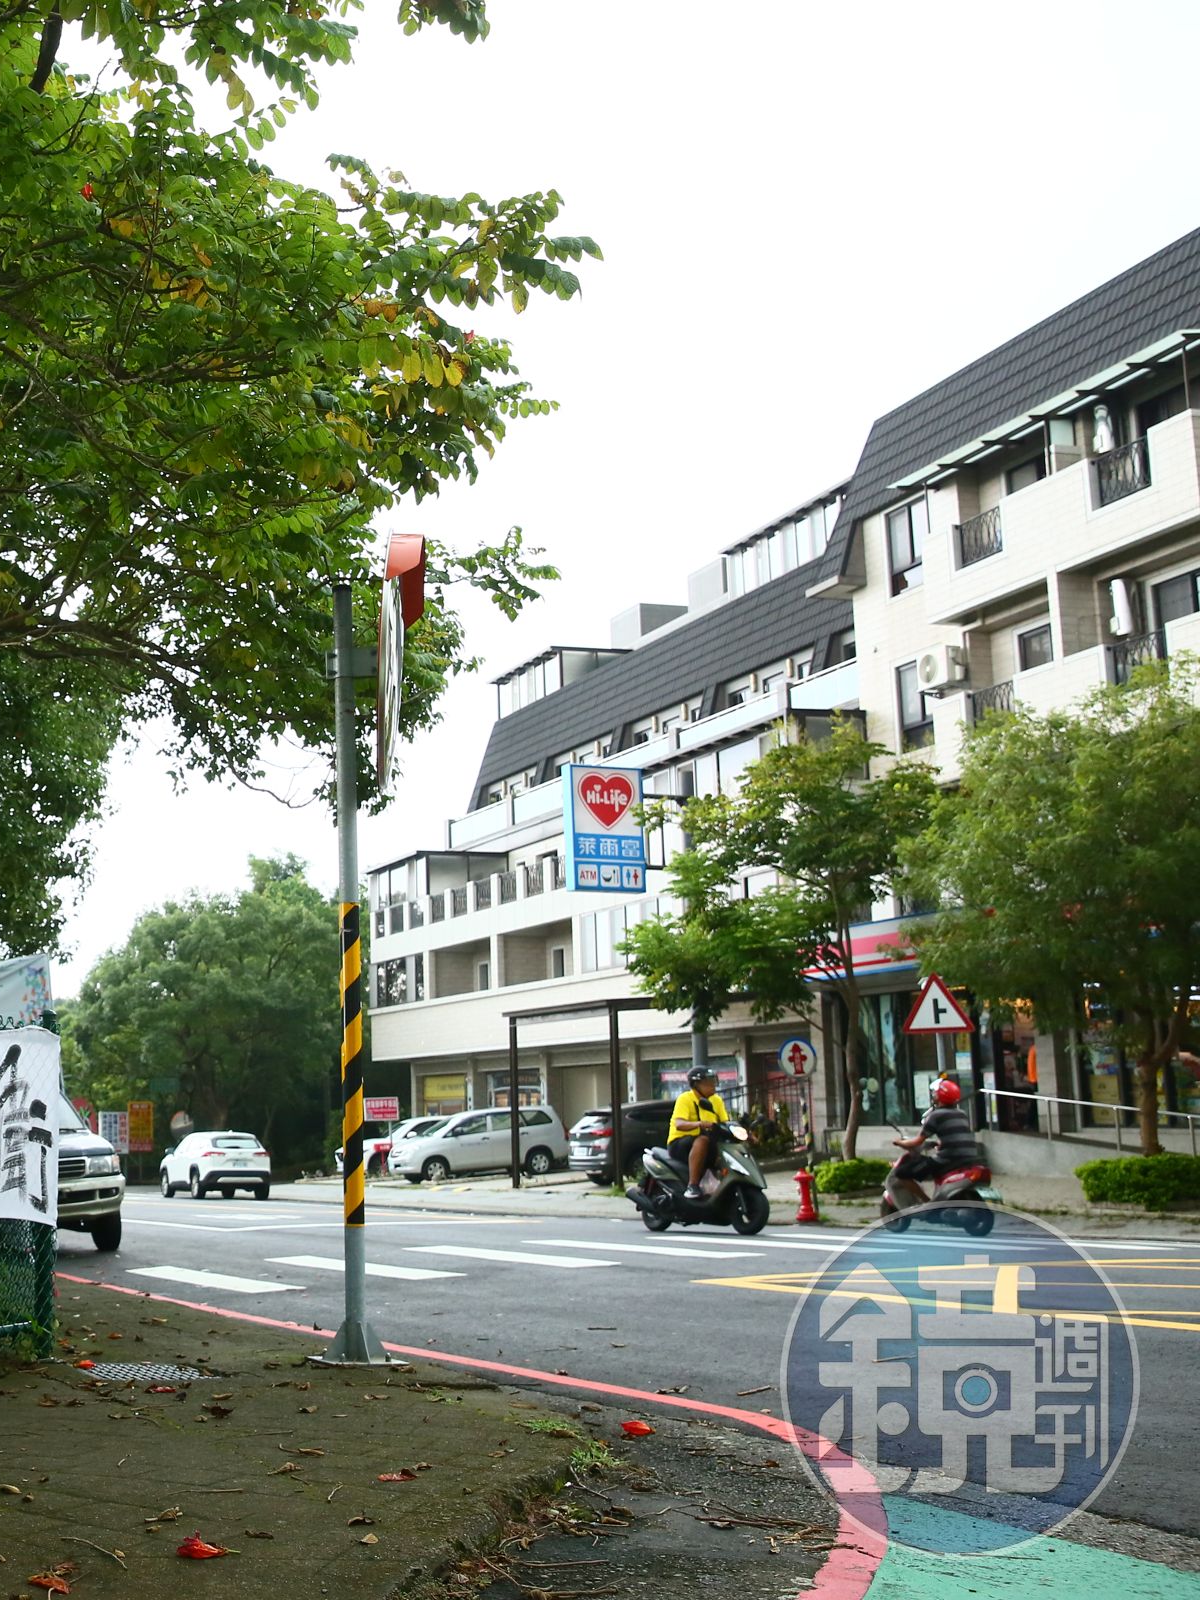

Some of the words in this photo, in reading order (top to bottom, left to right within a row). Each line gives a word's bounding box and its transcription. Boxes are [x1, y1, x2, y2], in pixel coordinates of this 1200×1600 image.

[586, 784, 628, 813] Hi-Life
[577, 837, 641, 858] 萊爾富
[580, 869, 597, 880] ATM
